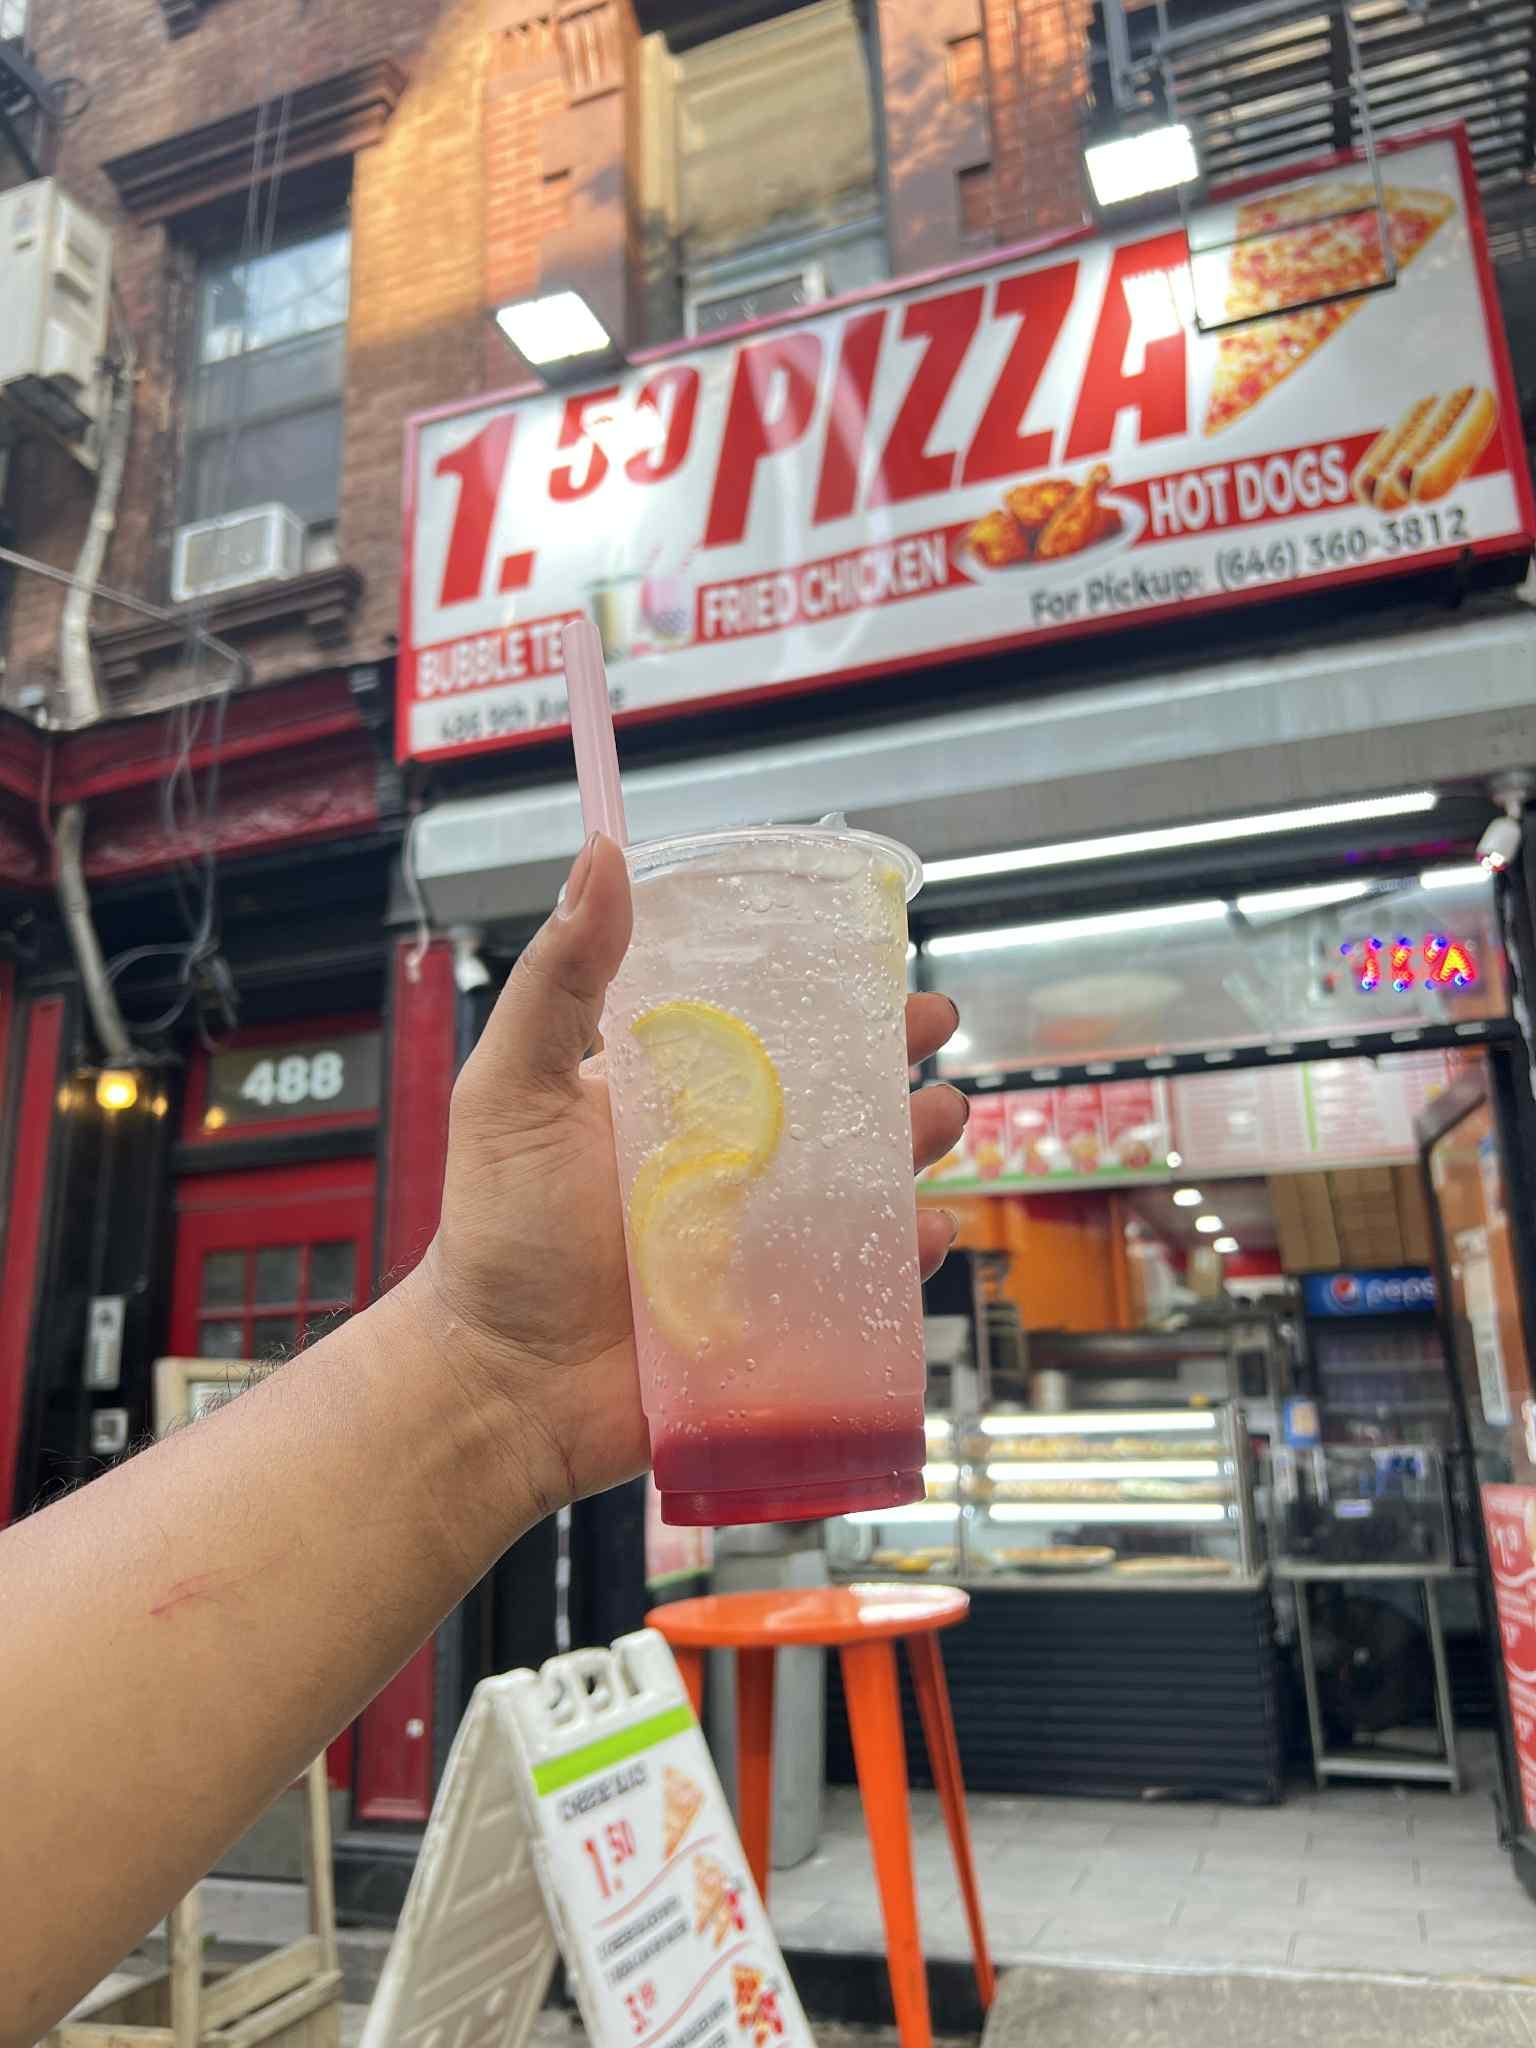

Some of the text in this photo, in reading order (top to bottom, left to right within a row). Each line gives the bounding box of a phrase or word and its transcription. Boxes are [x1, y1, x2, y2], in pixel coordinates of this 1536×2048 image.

[704, 230, 1189, 548] PIZZA
[1147, 446, 1348, 537] HOT DOGS
[703, 536, 948, 640] FRIED CHICKEN
[1030, 507, 1470, 624] For Pickup: (646) 360-3812
[418, 620, 566, 698] BUBBLE TE
[241, 1051, 344, 1106] 488
[1365, 1276, 1437, 1309] peps
